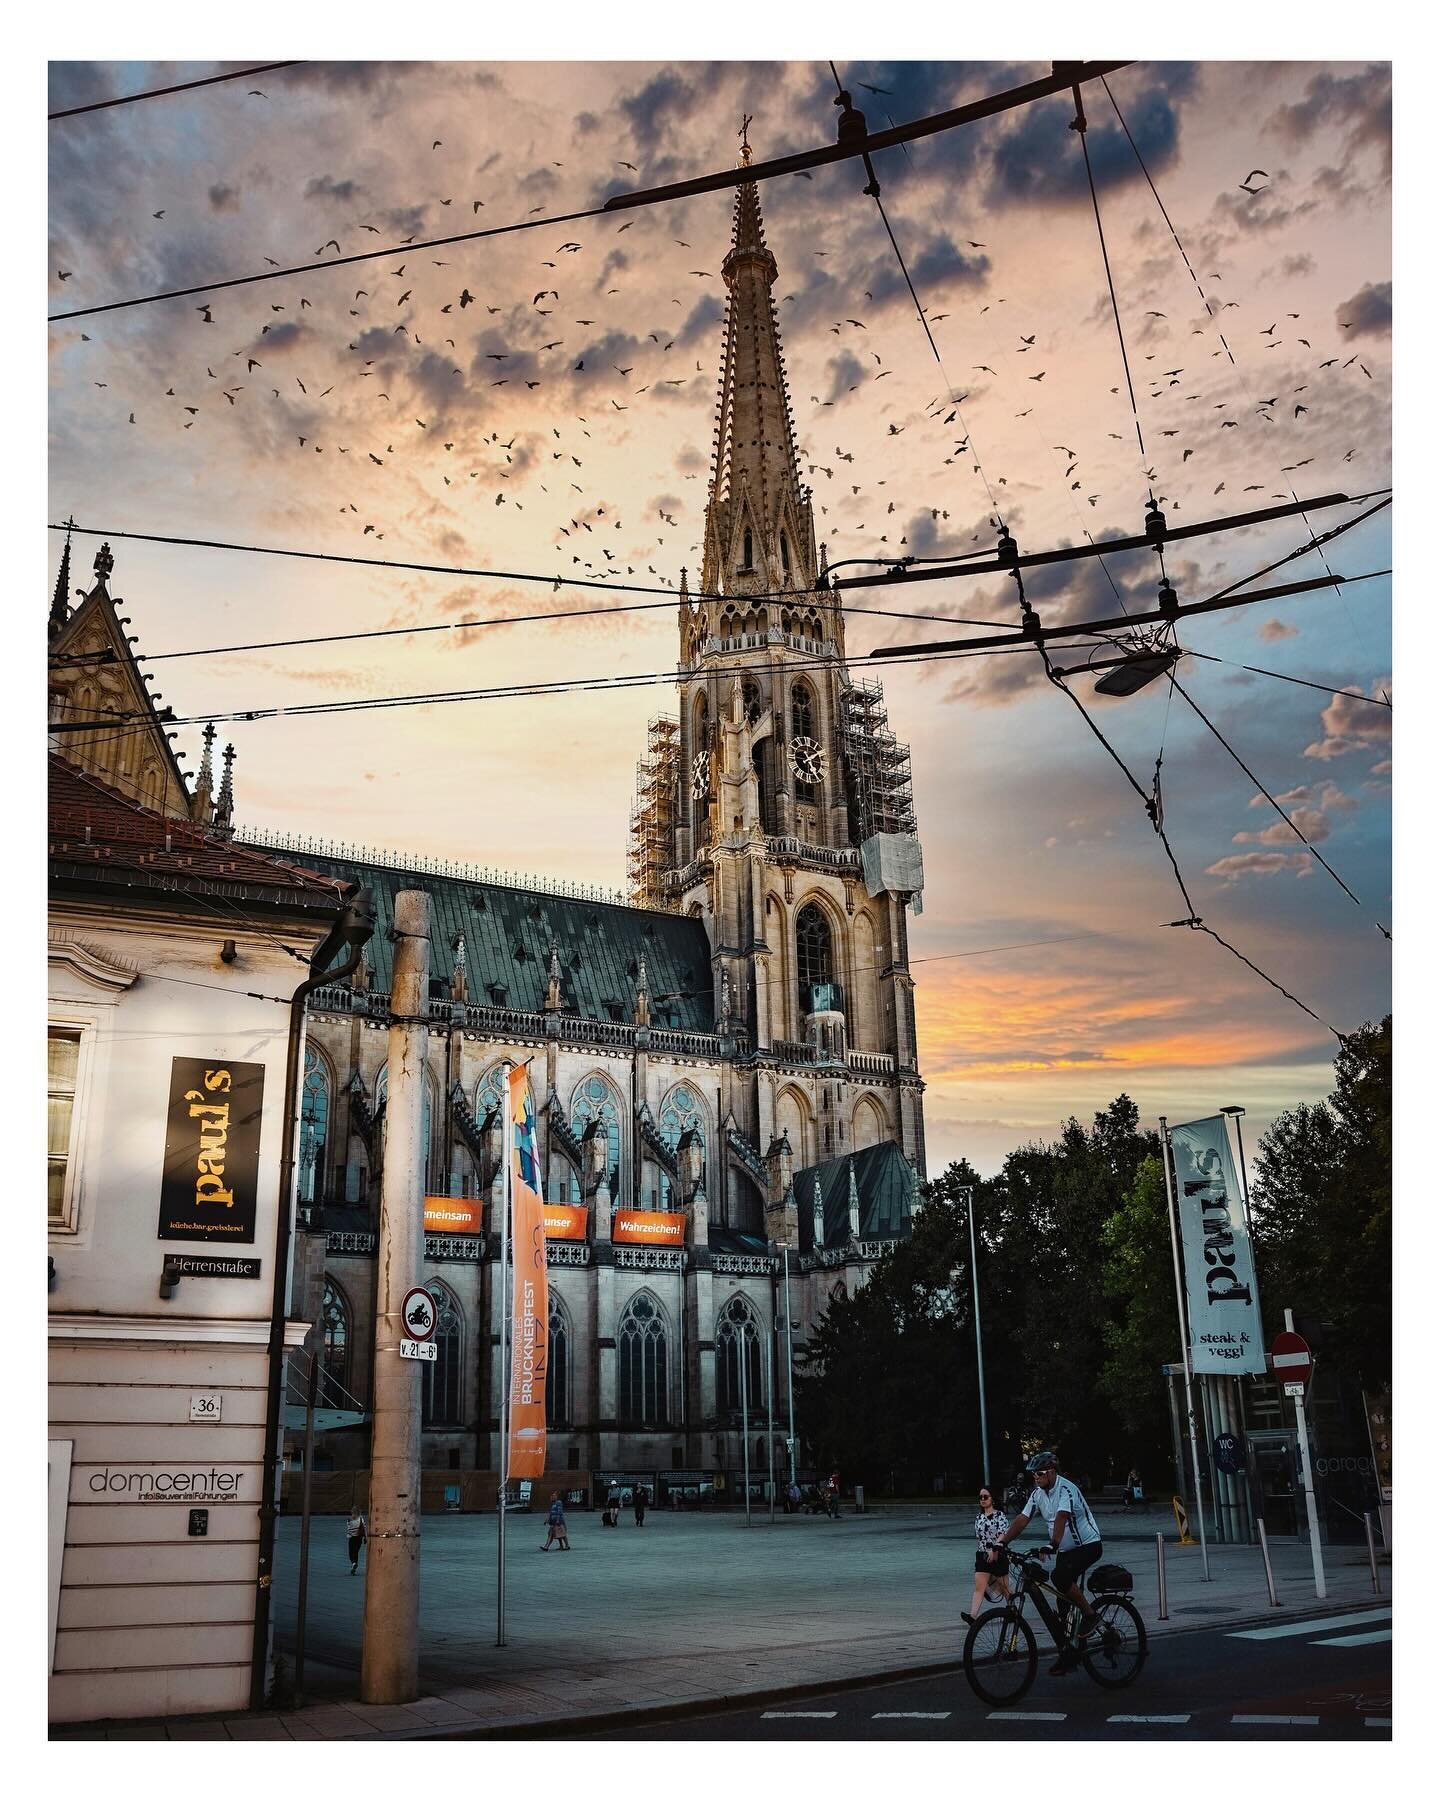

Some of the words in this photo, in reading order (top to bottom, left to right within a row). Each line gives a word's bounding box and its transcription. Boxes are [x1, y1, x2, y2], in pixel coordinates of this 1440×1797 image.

[183, 1069, 234, 1208] paul's
[544, 1218, 571, 1228] unser
[620, 1221, 681, 1234] Wahrzeichen!
[173, 1258, 252, 1274] Herrenstraße
[521, 1279, 534, 1405] BRUCKNERFEST
[1200, 1331, 1236, 1344] steak
[1240, 1331, 1251, 1344] &
[512, 1317, 522, 1405] INTERNATIONALES
[1219, 1439, 1234, 1450] WC
[89, 1468, 244, 1492] domcenter
